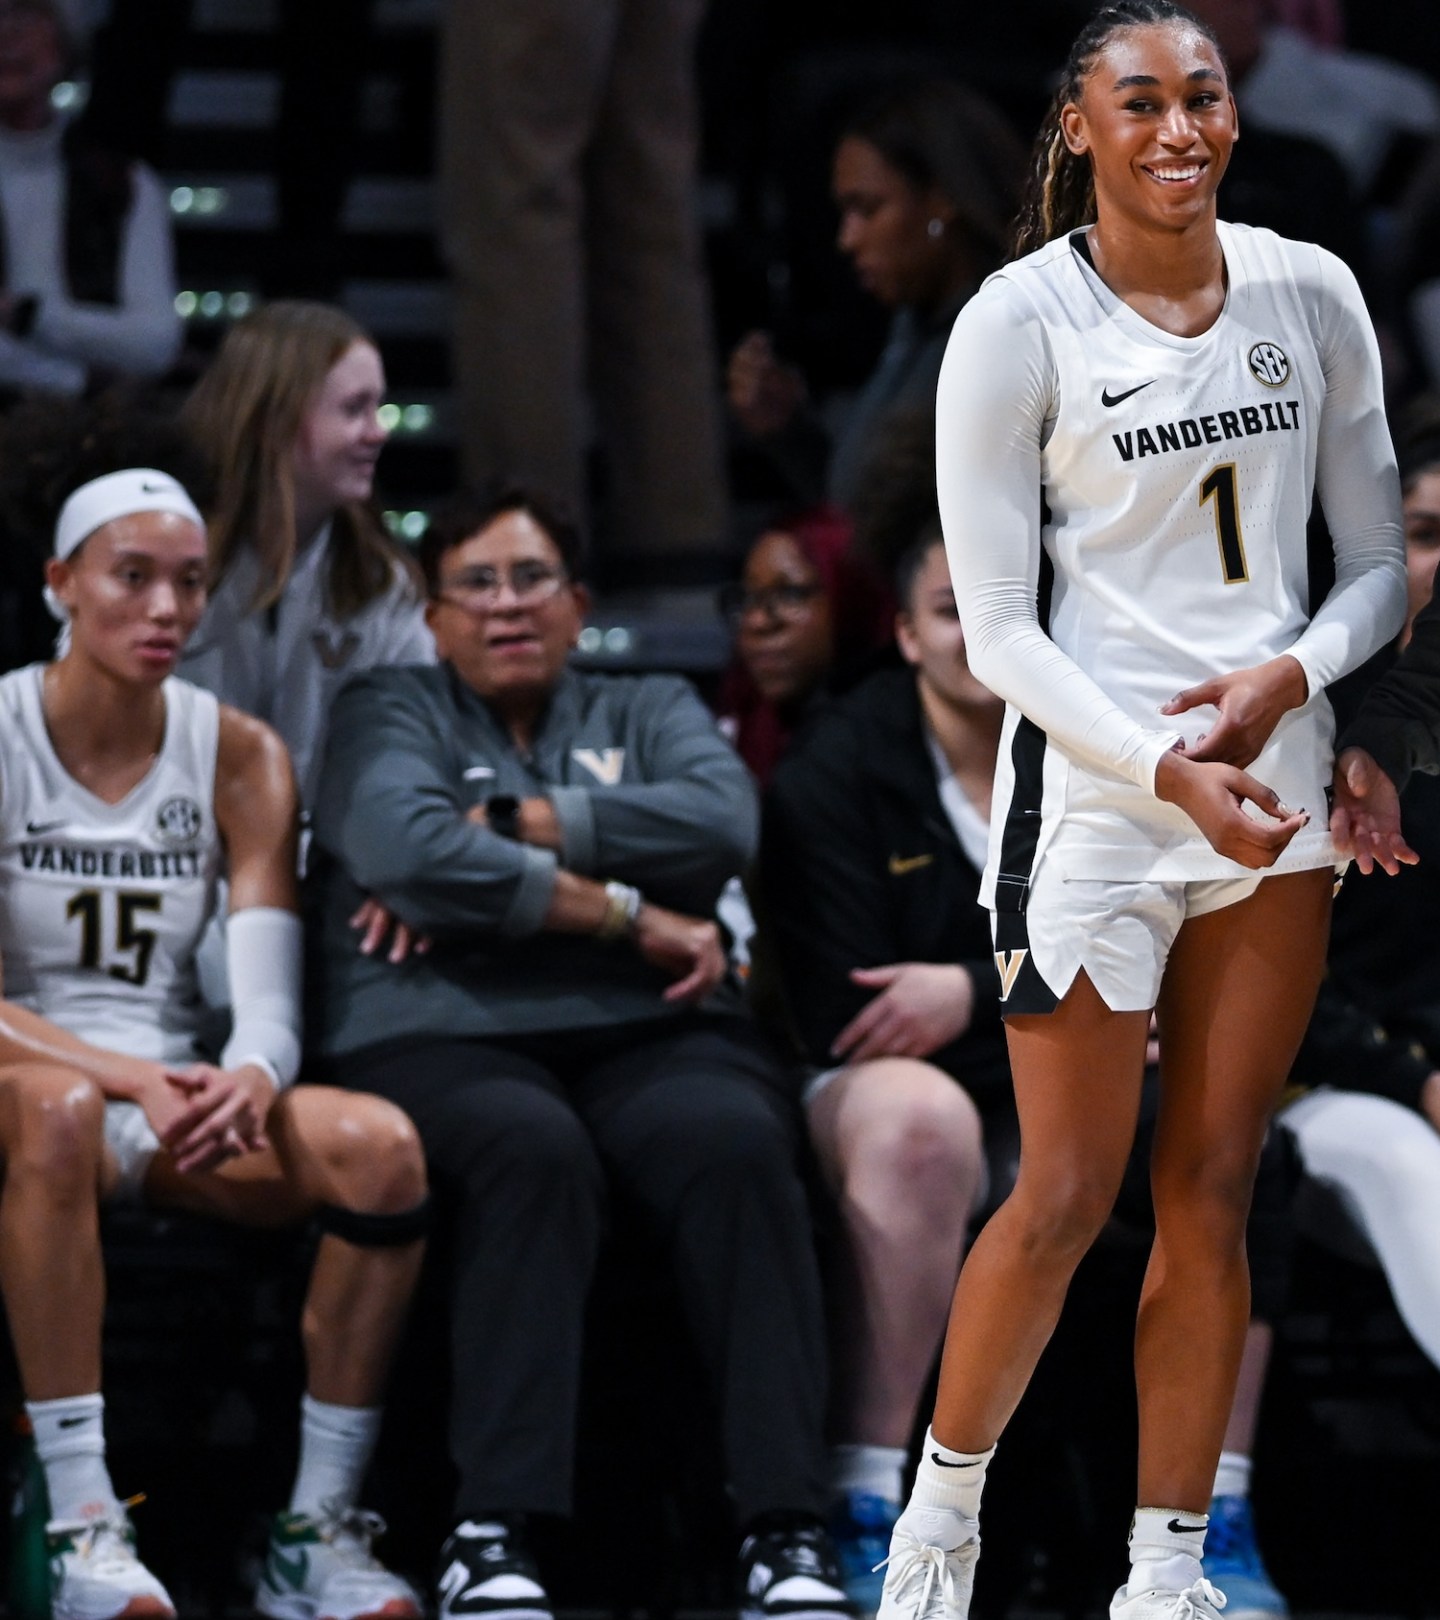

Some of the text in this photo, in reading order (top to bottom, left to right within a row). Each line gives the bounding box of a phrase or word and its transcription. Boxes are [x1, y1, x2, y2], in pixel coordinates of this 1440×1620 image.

[1250, 344, 1288, 384] SEC
[1113, 401, 1300, 462] VANDERBILT
[1199, 462, 1249, 585] 1
[571, 747, 625, 785] V
[20, 843, 200, 878] VANDERBILT
[67, 888, 162, 987] 15
[994, 948, 1029, 1002] V
